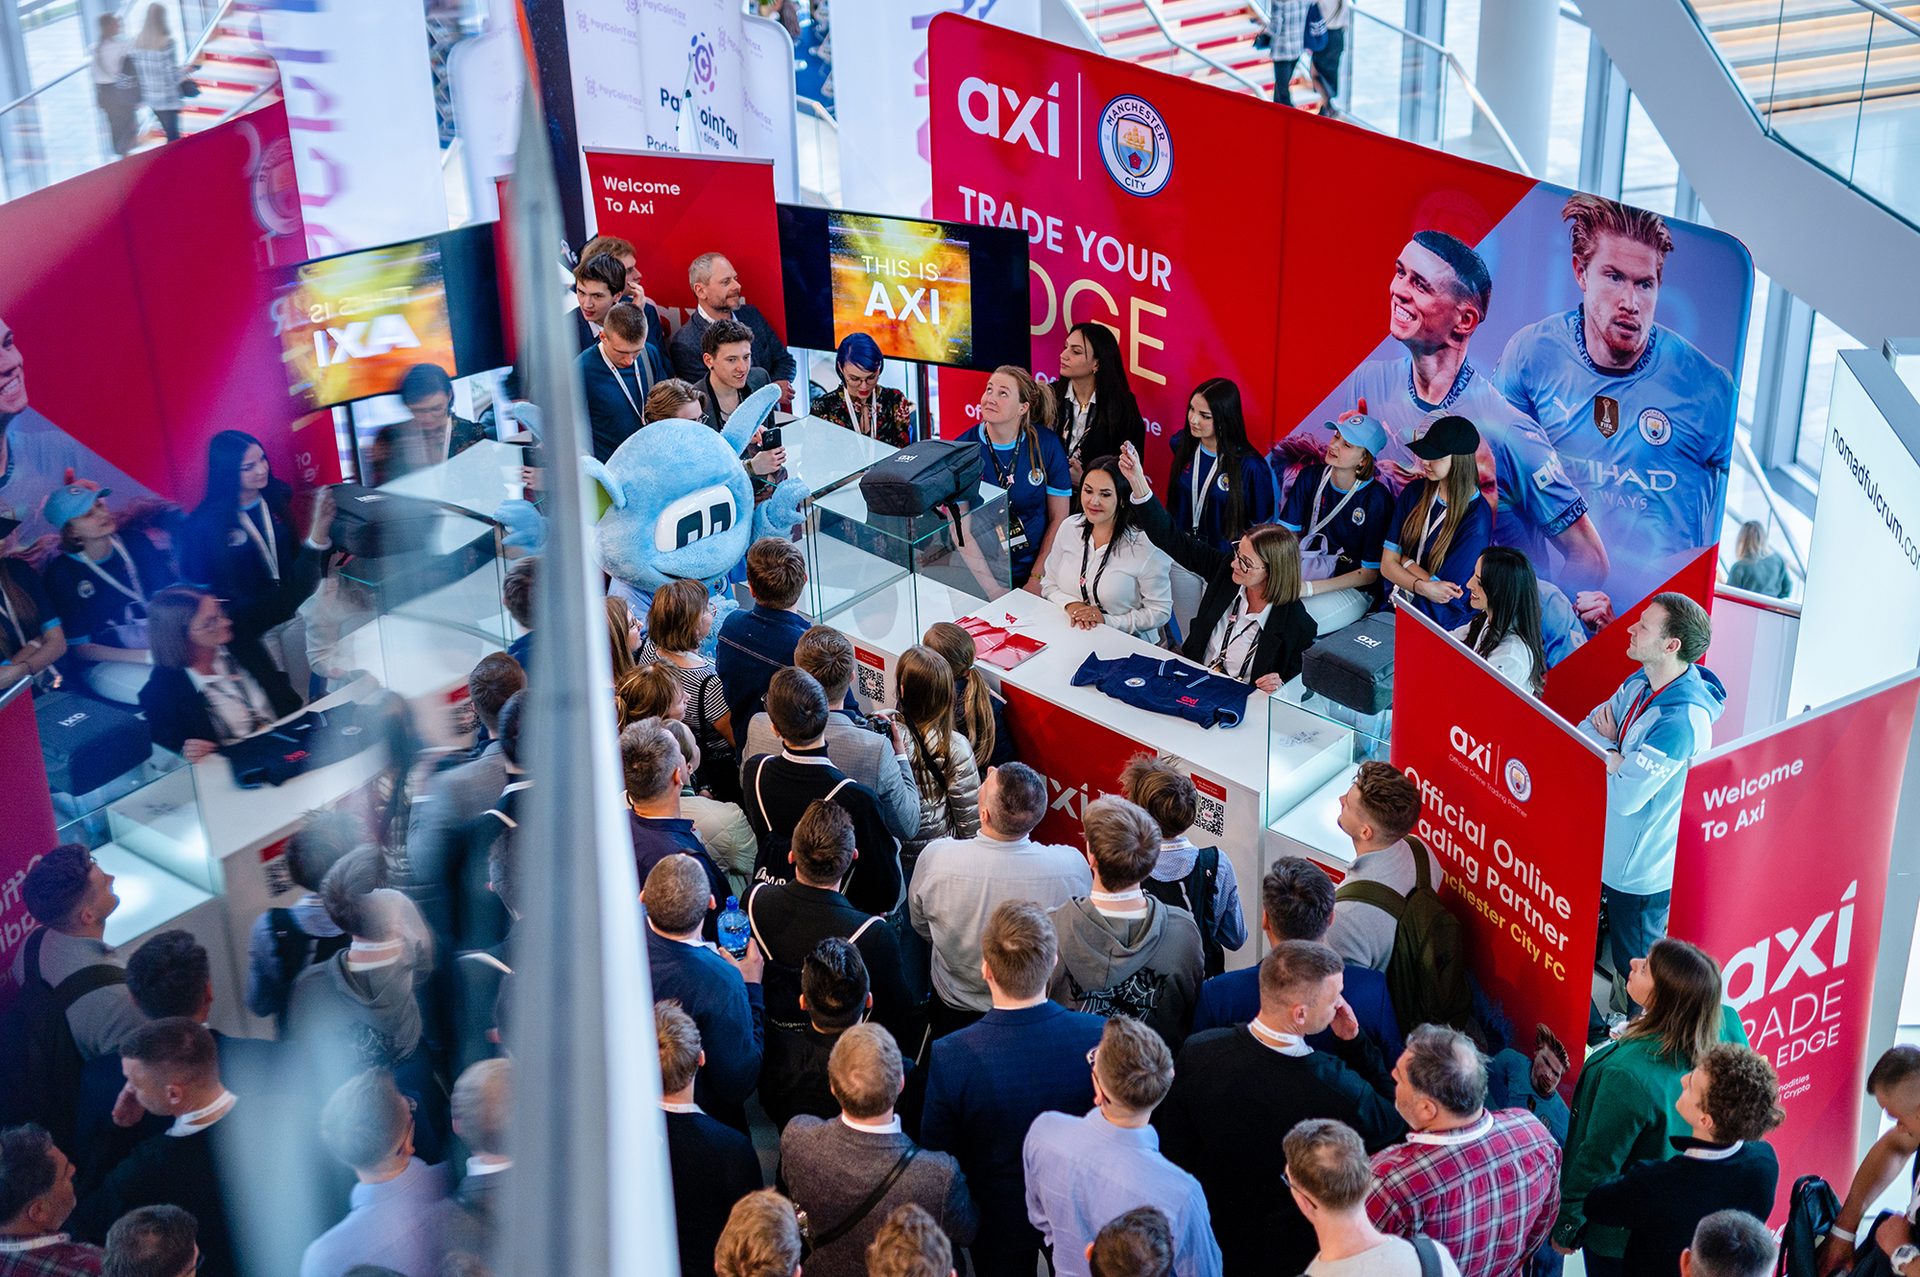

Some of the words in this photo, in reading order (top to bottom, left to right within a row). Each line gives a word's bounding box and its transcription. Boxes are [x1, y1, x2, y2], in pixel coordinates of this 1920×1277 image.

[660, 87, 739, 149] PaoinTax
[957, 76, 1060, 158] axi
[1106, 101, 1166, 142] MANCHESTER
[602, 175, 681, 196] Welcome
[604, 197, 623, 212] To
[628, 199, 655, 215] Axi
[1124, 176, 1147, 190] CITY
[958, 185, 1064, 254] TRADE
[1075, 225, 1172, 292] YOUR
[861, 255, 911, 279] THIS
[919, 262, 940, 282] IS
[864, 280, 940, 326] AXI
[1030, 259, 1167, 386] DGE
[1357, 635, 1382, 648] axi
[1449, 725, 1492, 775] axi
[1040, 773, 1089, 821] xi
[1703, 759, 1804, 812] Welcome
[1701, 820, 1729, 843] To
[1734, 798, 1766, 833] Axi
[1417, 818, 1480, 885] ading
[1486, 866, 1570, 952] Partner
[1493, 838, 1572, 921] Online
[1441, 867, 1506, 930] nchester
[1510, 922, 1541, 963] City
[1544, 952, 1566, 982] FC
[1720, 879, 1858, 1013] axi
[1776, 1023, 1841, 1069] EDGE
[1783, 1083, 1811, 1100] Crypto
